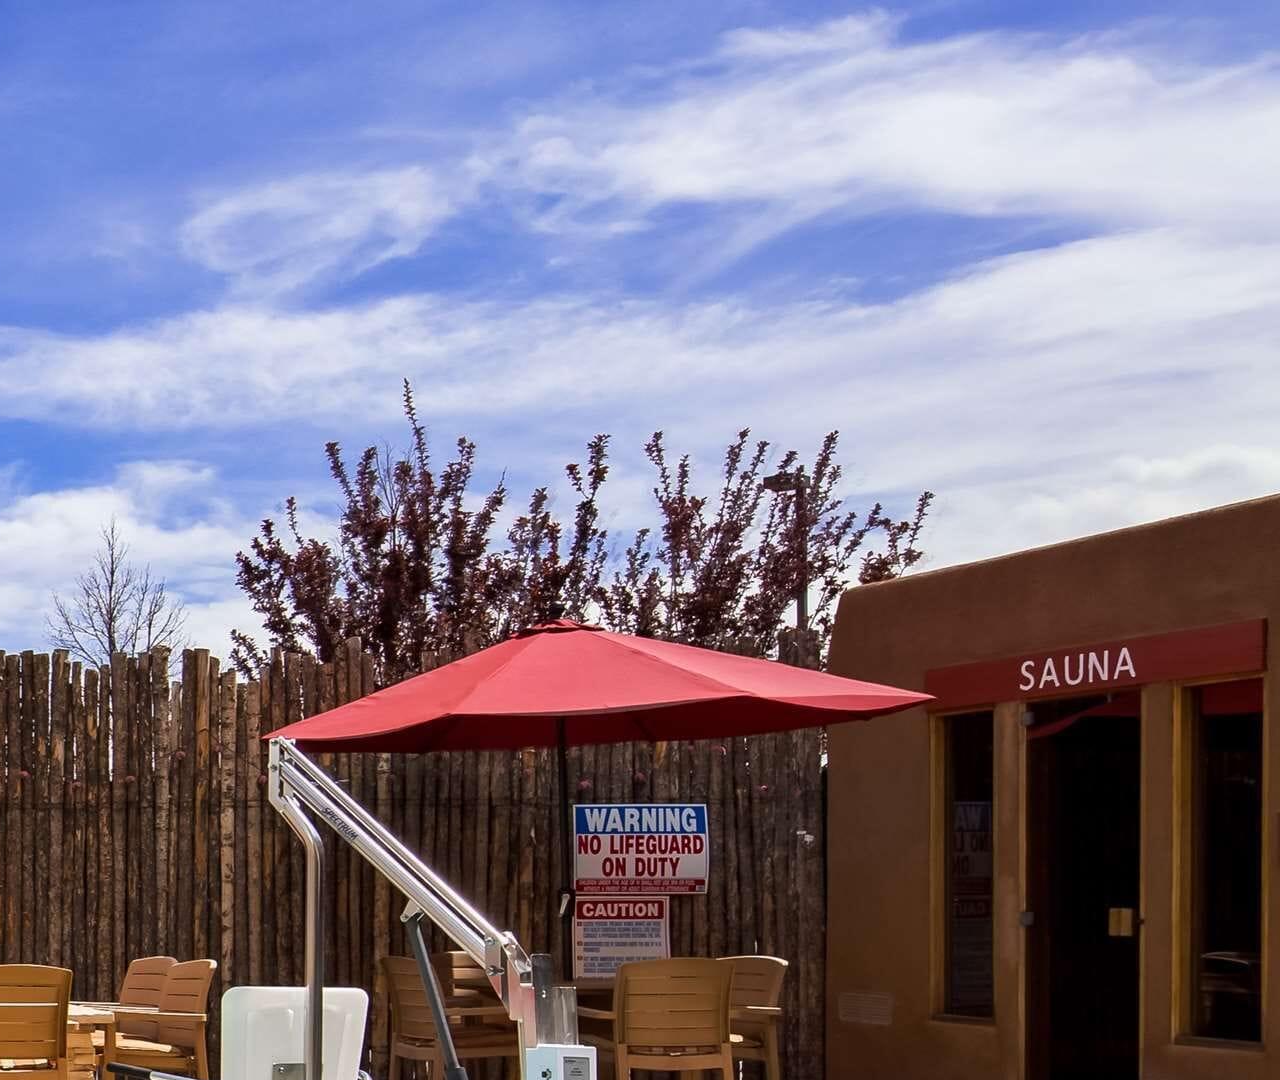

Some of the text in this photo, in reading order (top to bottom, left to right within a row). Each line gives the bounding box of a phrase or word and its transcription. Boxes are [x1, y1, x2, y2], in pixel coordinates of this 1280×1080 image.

[1019, 646, 1136, 691] SAUNA
[584, 807, 697, 833] WARNING
[577, 834, 704, 855] NO LIFEGUARD
[601, 856, 681, 878] ON DUTY
[581, 902, 660, 918] CAUTION
